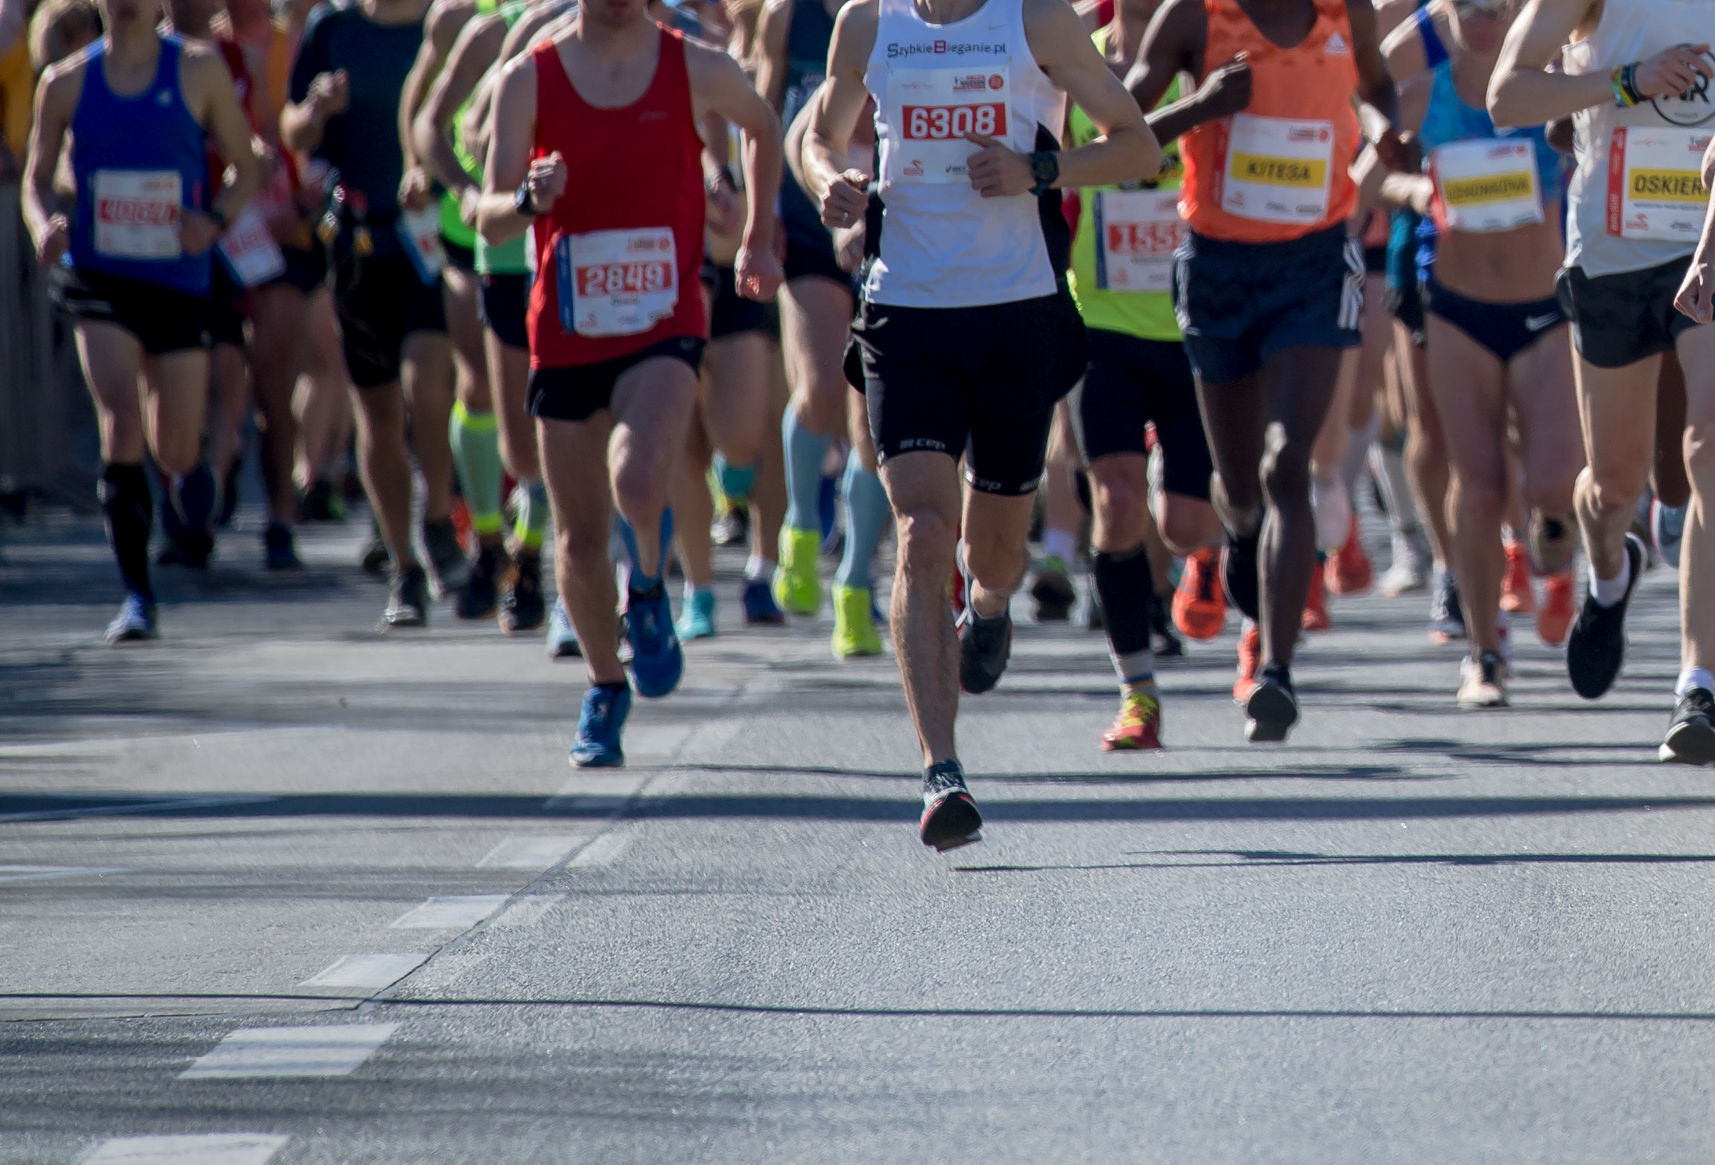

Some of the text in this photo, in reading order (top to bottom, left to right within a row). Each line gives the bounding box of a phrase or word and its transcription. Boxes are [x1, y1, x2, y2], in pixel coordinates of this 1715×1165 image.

[887, 40, 1006, 57] SzybkieBieganie.pl
[910, 105, 996, 138] 6308
[1635, 174, 1705, 196] OSKIER
[585, 264, 664, 295] 2849
